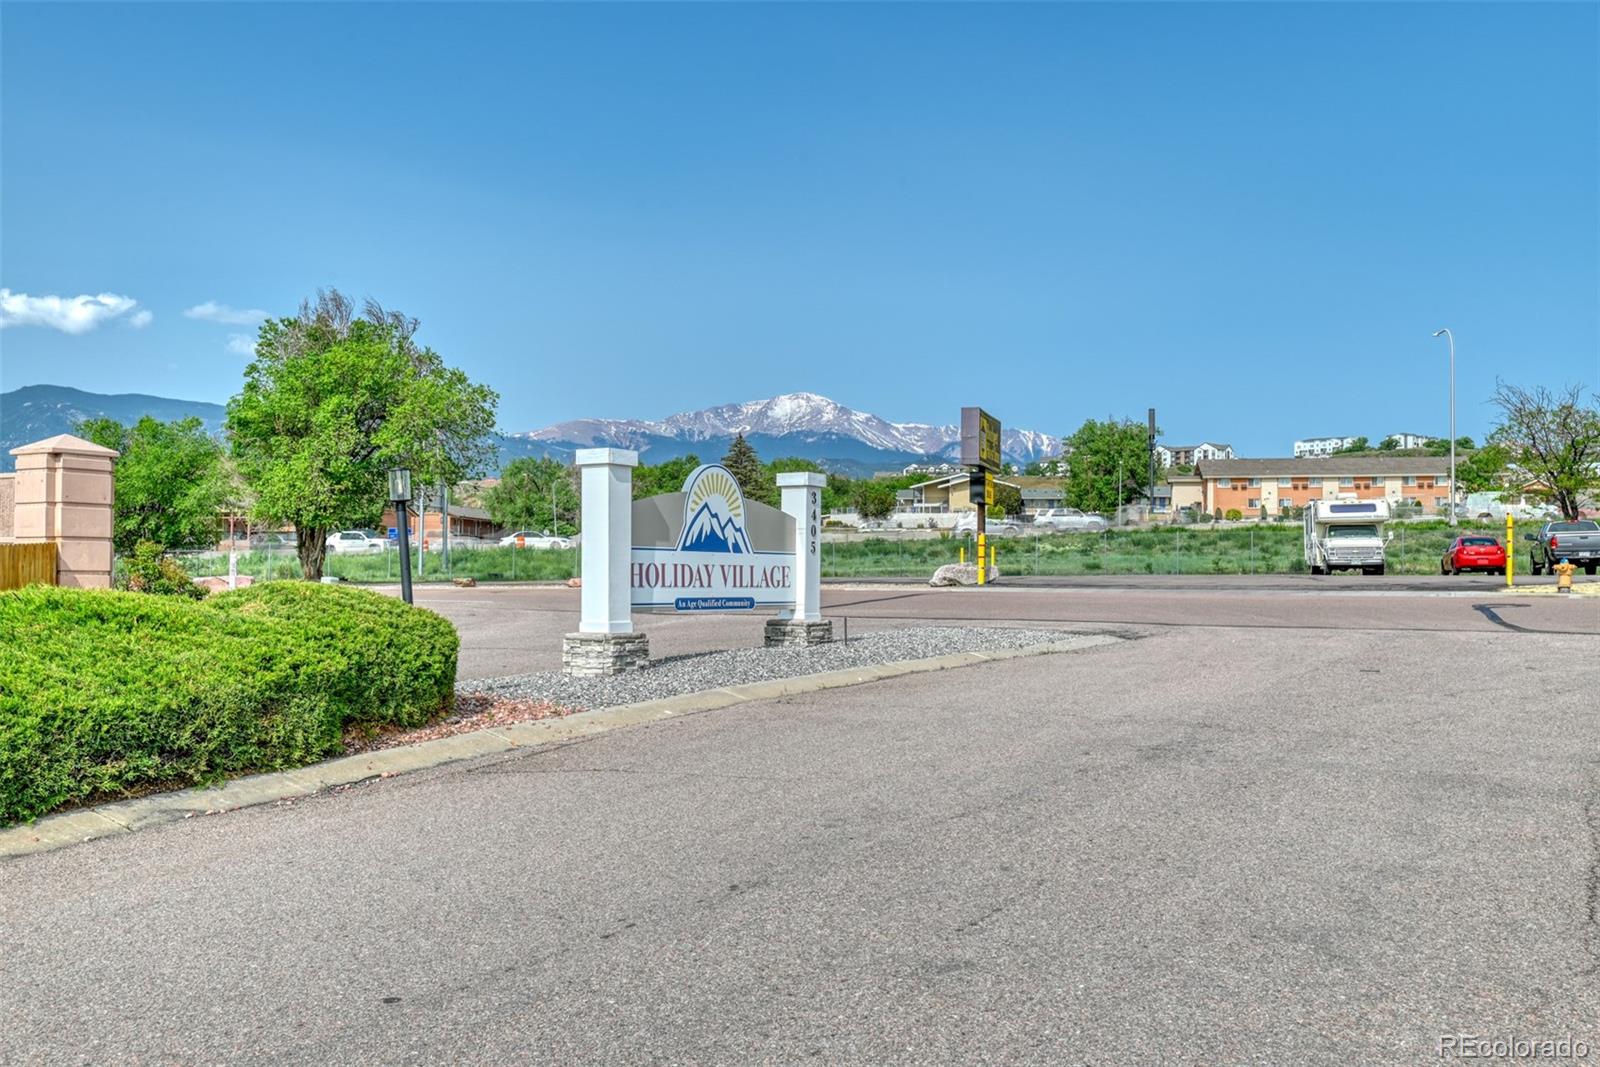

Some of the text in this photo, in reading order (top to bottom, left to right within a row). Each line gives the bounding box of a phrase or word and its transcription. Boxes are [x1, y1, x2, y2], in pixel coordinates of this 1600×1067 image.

[810, 491, 818, 553] 3405
[631, 561, 792, 589] HOLIDAY VILLAGE
[678, 598, 751, 609] An Age Qualified Community
